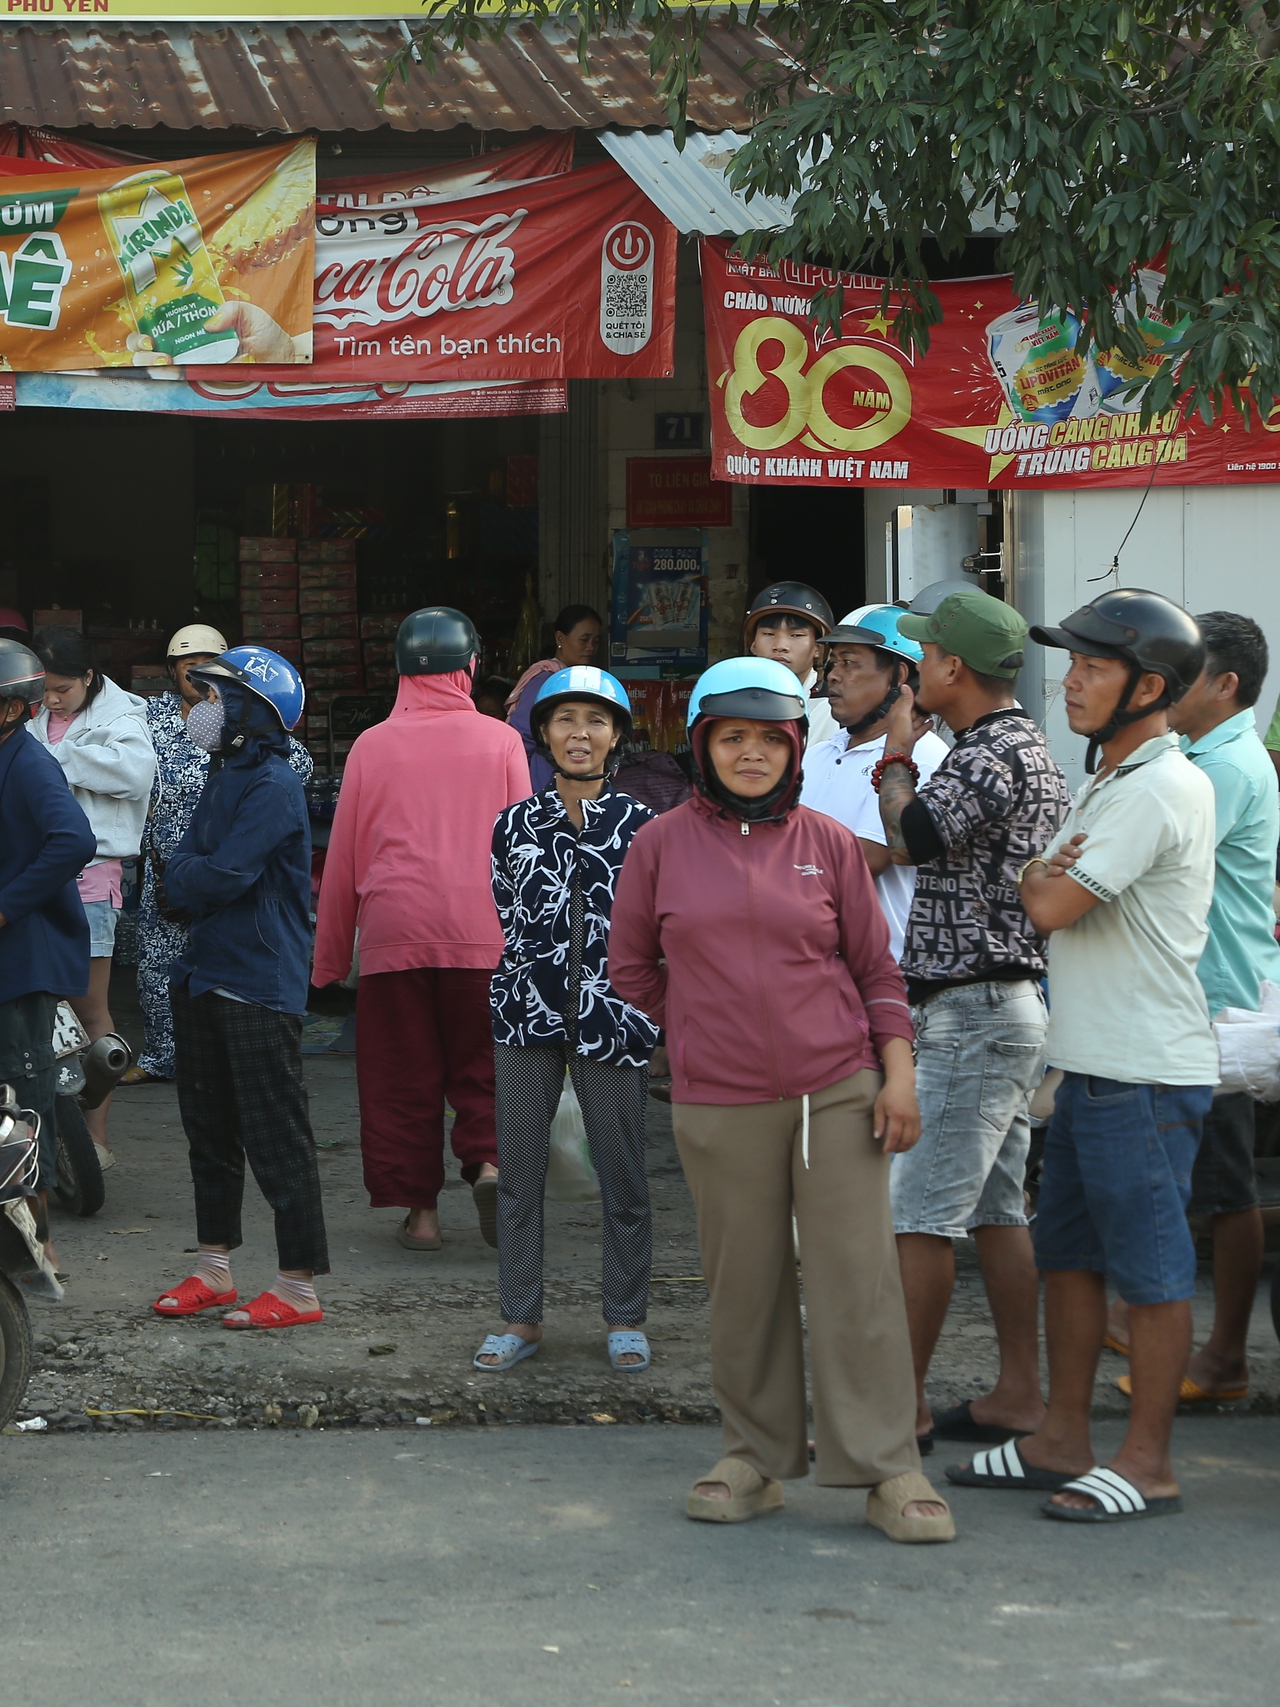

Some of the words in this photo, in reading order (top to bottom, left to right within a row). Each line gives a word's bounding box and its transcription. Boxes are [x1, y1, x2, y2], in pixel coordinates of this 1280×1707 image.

[724, 289, 768, 311] CHÀO
[333, 335, 382, 356] Tìm
[389, 335, 433, 355] tên
[440, 334, 489, 359] bạn
[497, 332, 562, 355] thích
[852, 389, 891, 409] NĂM
[665, 416, 692, 440] 71
[984, 420, 1049, 454] UỐNG
[1049, 412, 1111, 446] CÀNG
[725, 451, 761, 476] QUỐC
[765, 456, 822, 477] KHÁNH
[827, 457, 866, 481] VIỆT
[869, 461, 909, 479] NAM
[1015, 446, 1091, 478] TRÚNG
[1090, 438, 1154, 470] CÀNG
[678, 690, 692, 699] NGO
